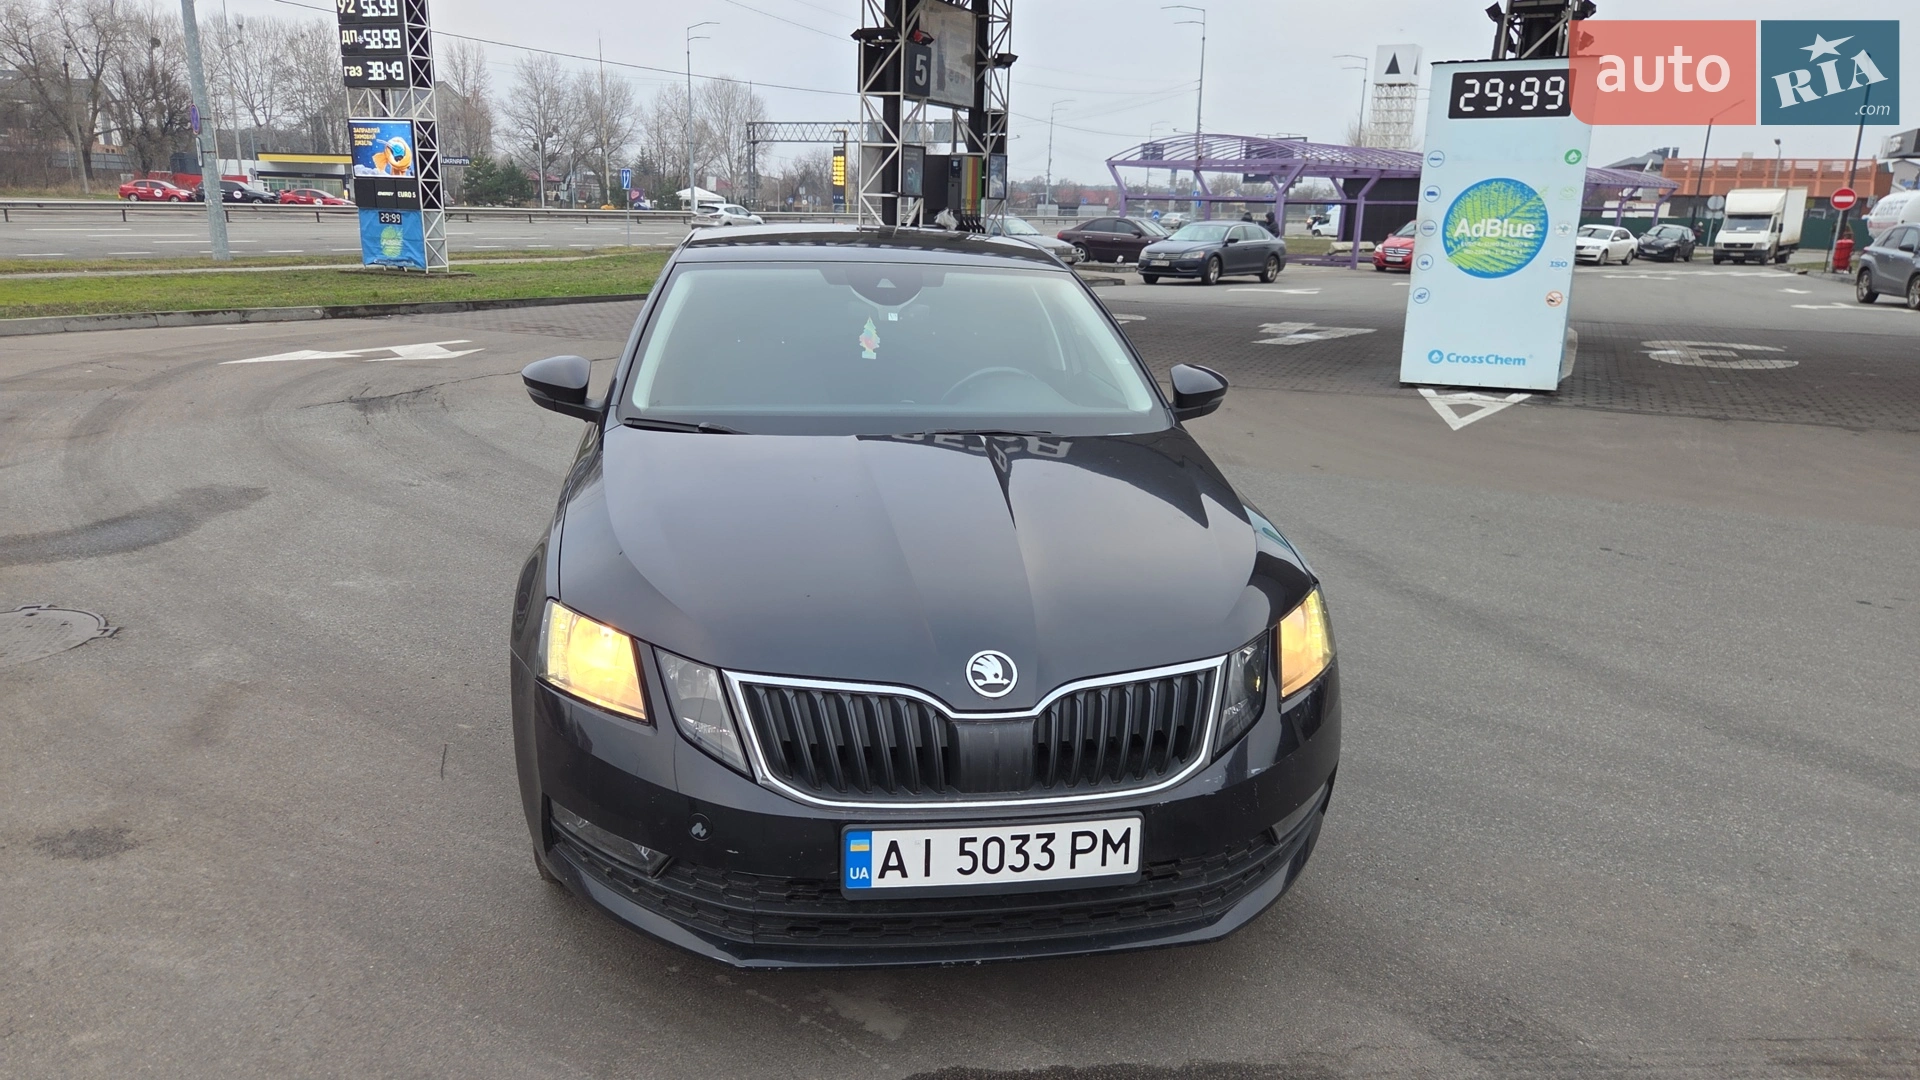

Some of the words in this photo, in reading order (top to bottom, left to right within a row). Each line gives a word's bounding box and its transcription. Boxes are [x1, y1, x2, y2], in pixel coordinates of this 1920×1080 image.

[337, 0, 356, 14] 92
[341, 29, 358, 45] ДП
[363, 28, 402, 49] 58,99
[343, 65, 363, 77] газ
[366, 61, 405, 81] 38,49
[914, 54, 928, 87] 5
[1458, 76, 1566, 112] 29:99
[1453, 217, 1536, 238] AdBlue
[1549, 260, 1568, 268] ISO
[877, 838, 932, 880] AI
[956, 831, 1056, 877] 5033
[1069, 826, 1132, 870] PM
[849, 867, 869, 880] UA
